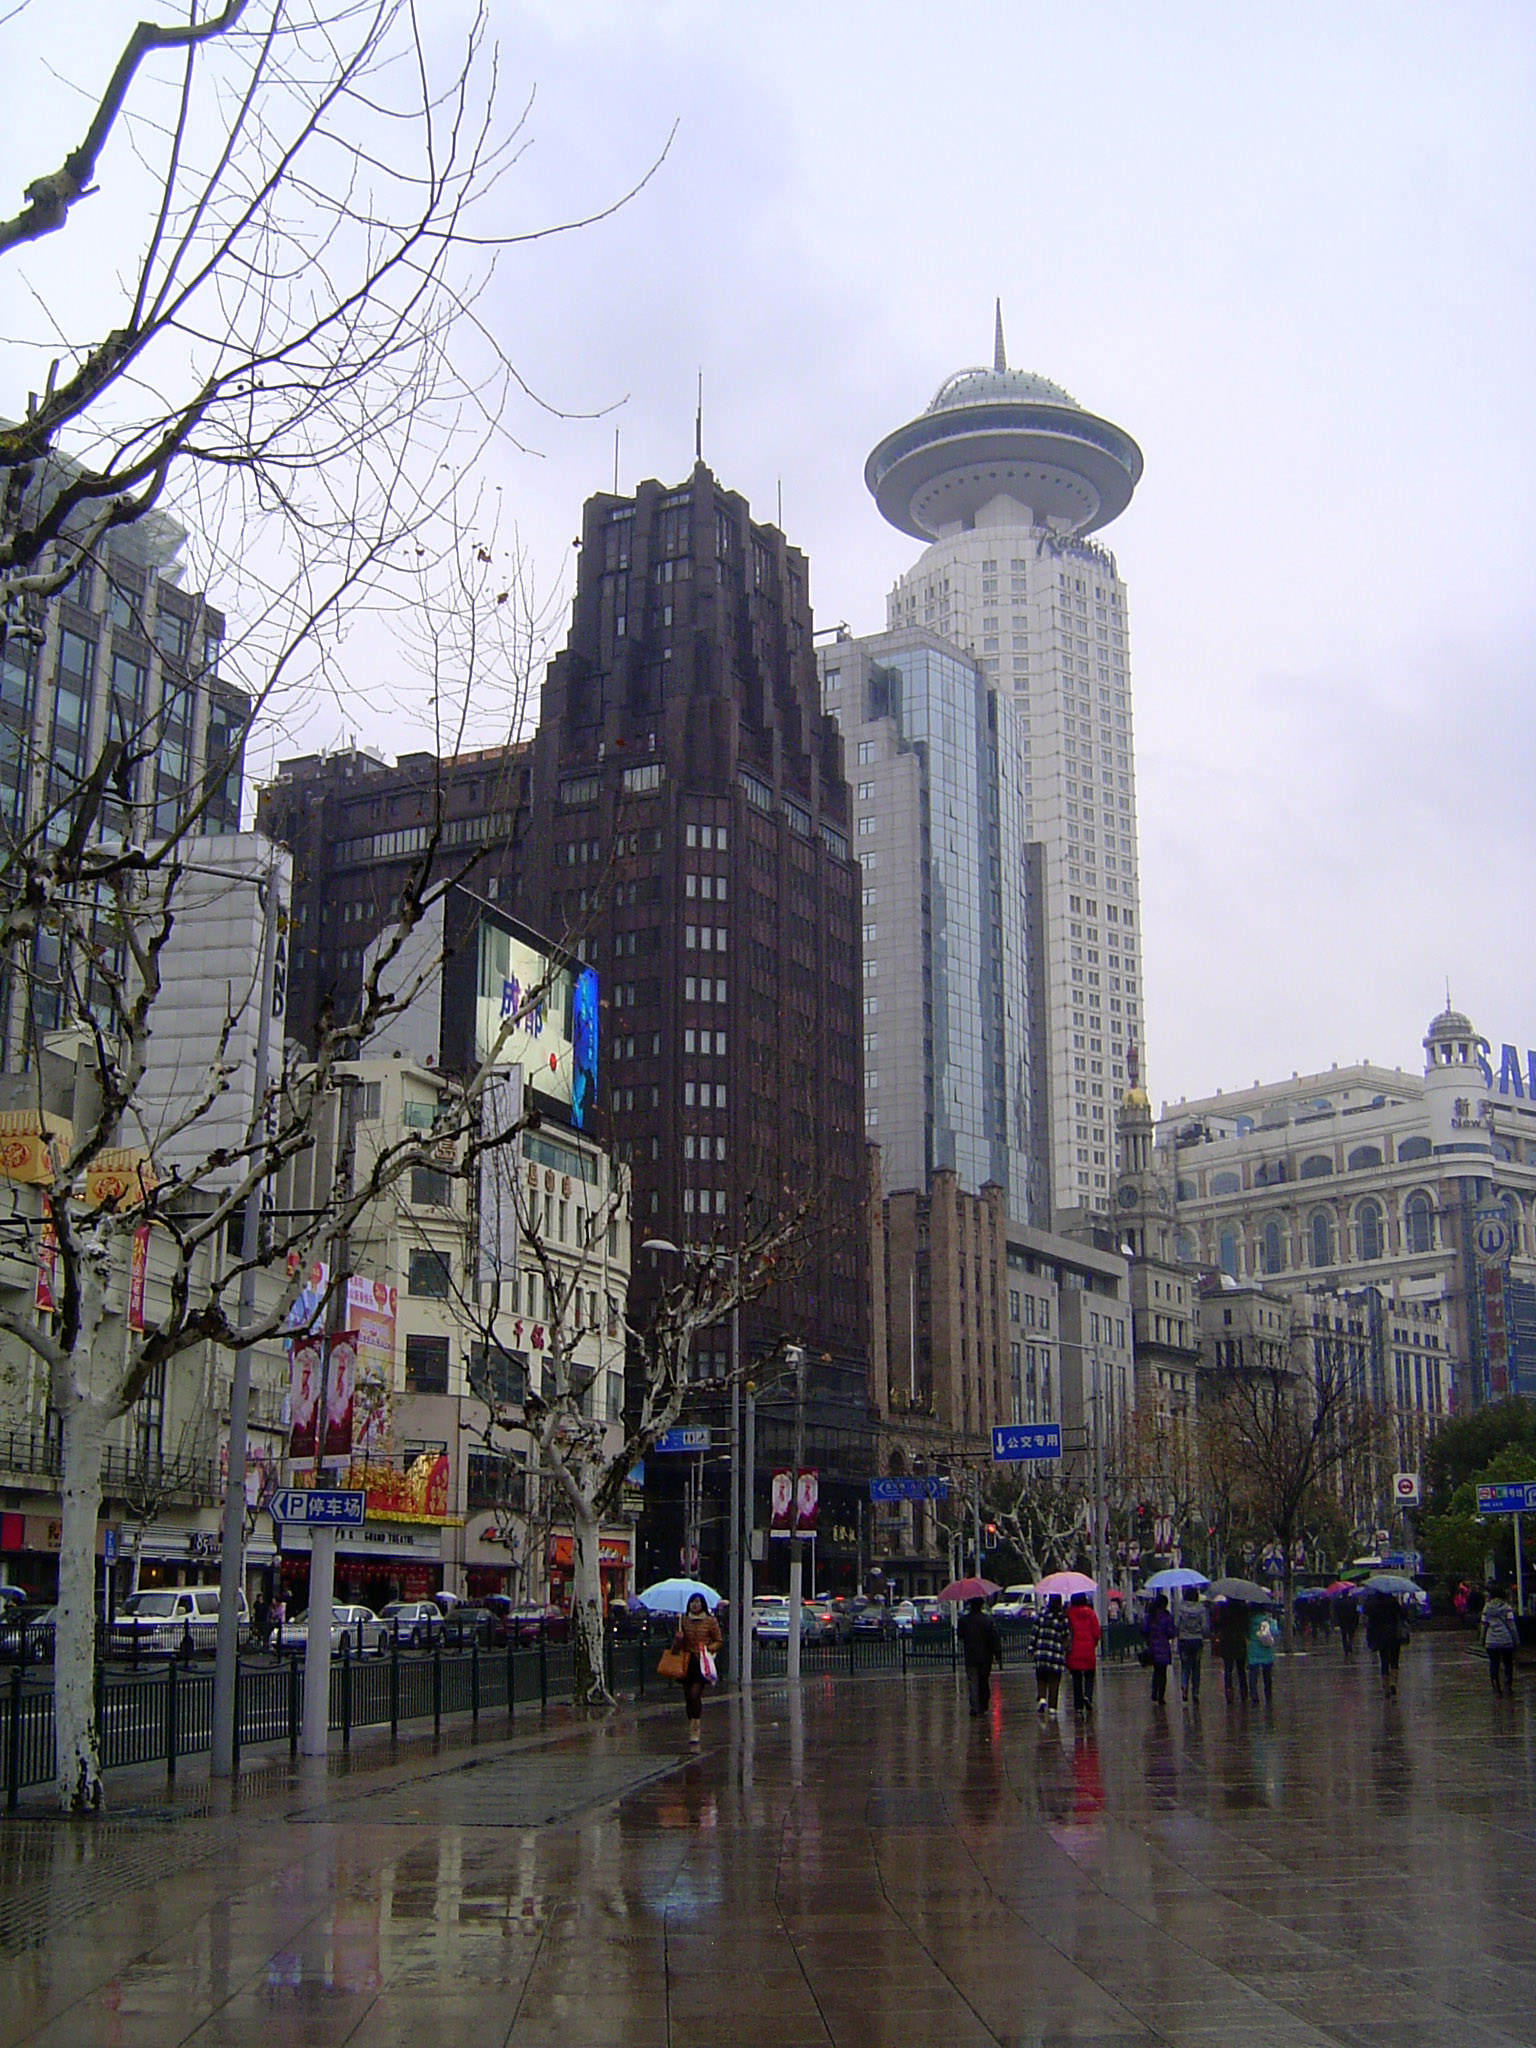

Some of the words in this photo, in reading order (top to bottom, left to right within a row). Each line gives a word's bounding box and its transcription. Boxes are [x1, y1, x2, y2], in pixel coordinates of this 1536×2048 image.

[1451, 1117, 1482, 1129] New
[1006, 1433, 1059, 1449] 公交专用
[290, 1497, 304, 1516] P
[308, 1497, 361, 1518] 停车场
